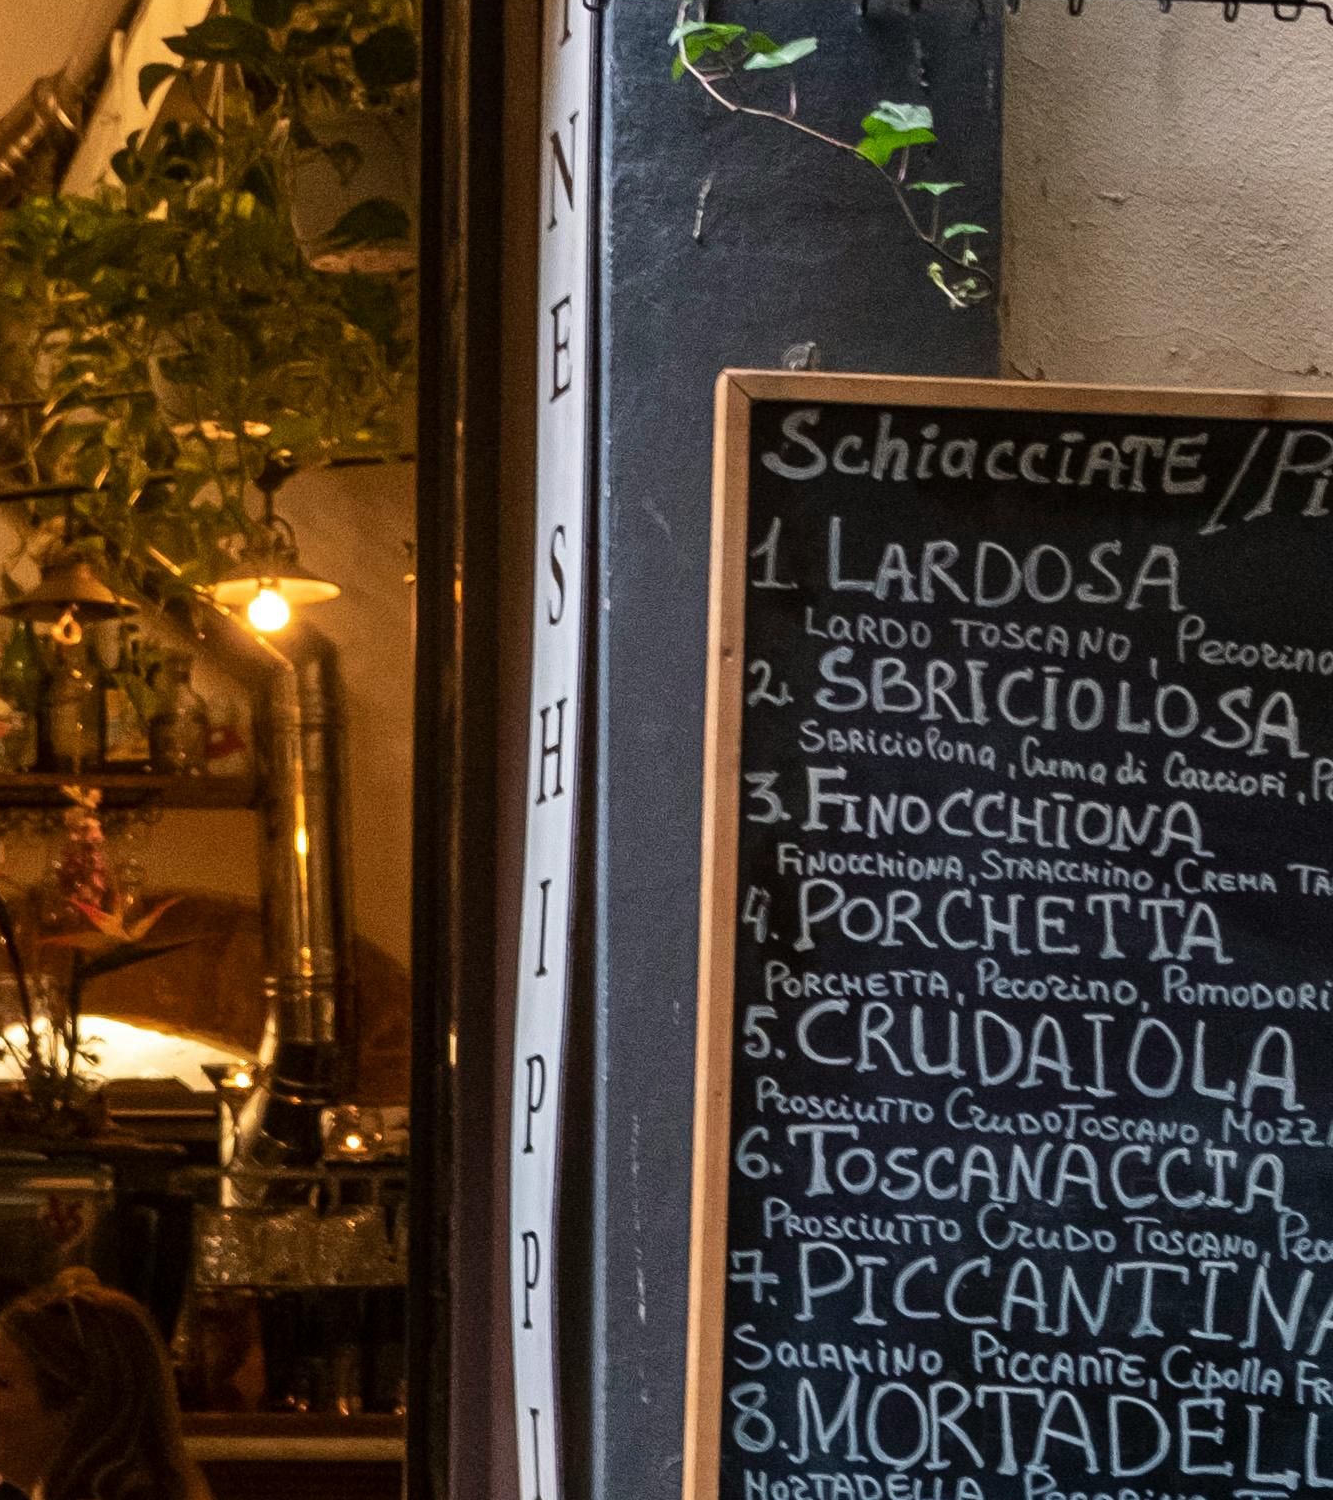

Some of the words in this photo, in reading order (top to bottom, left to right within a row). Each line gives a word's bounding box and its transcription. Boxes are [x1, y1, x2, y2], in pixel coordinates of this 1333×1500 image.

[827, 515, 1186, 612] LARDOSA
[814, 645, 1310, 759] SBRICIOLOSA
[1115, 750, 1148, 786] di
[793, 877, 1234, 966] PORCHETTA
[795, 998, 1307, 1113] CRUDAIOLA
[785, 1123, 1290, 1214] TOSCANACCIA
[1221, 1106, 1333, 1149] MOZZ
